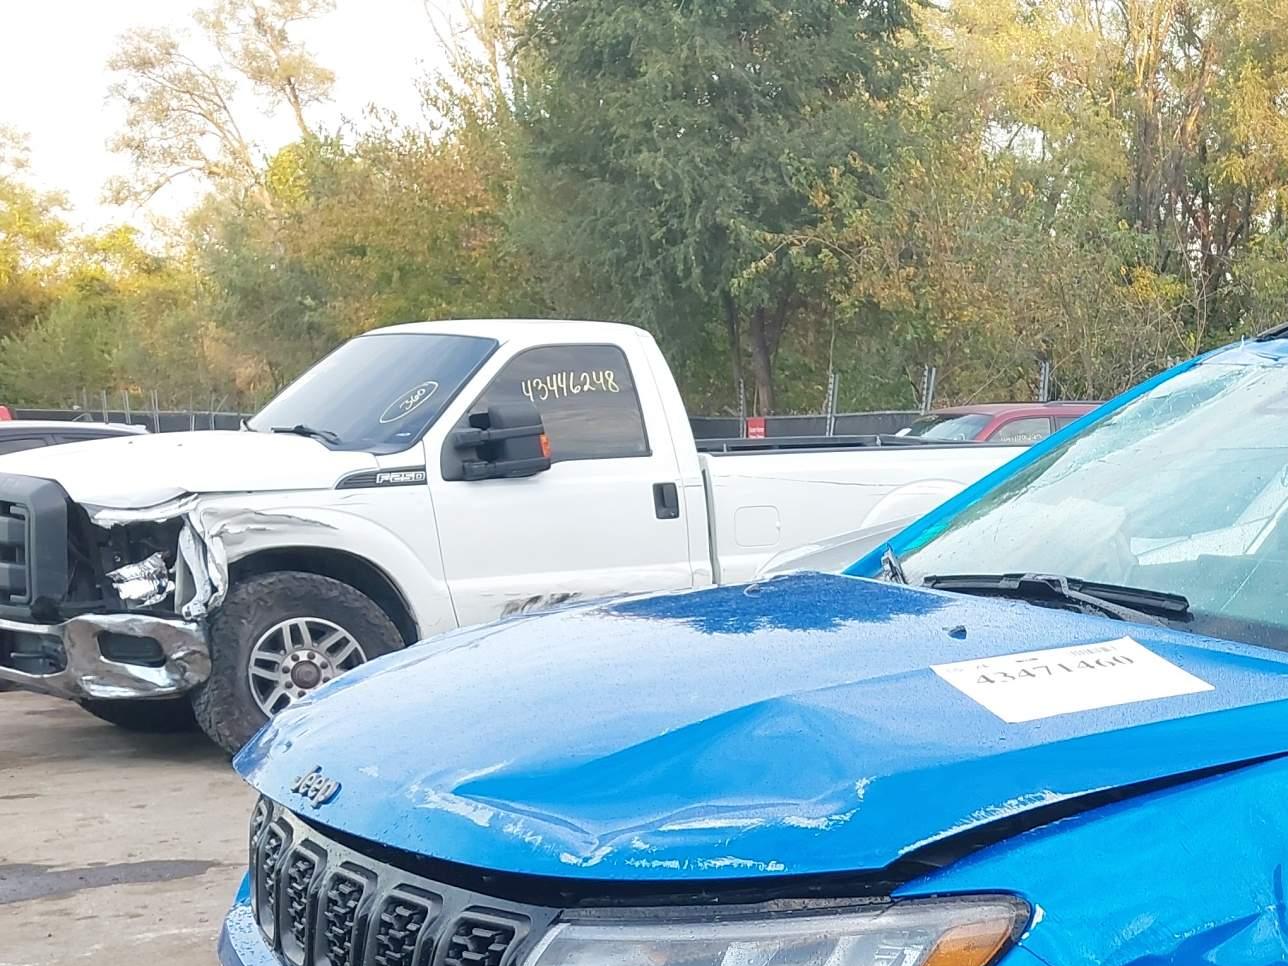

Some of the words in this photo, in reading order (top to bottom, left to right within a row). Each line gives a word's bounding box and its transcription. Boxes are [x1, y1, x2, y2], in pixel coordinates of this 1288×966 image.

[521, 370, 620, 403] 43446248
[976, 655, 1135, 685] 43471460
[290, 765, 342, 810] Jeep
